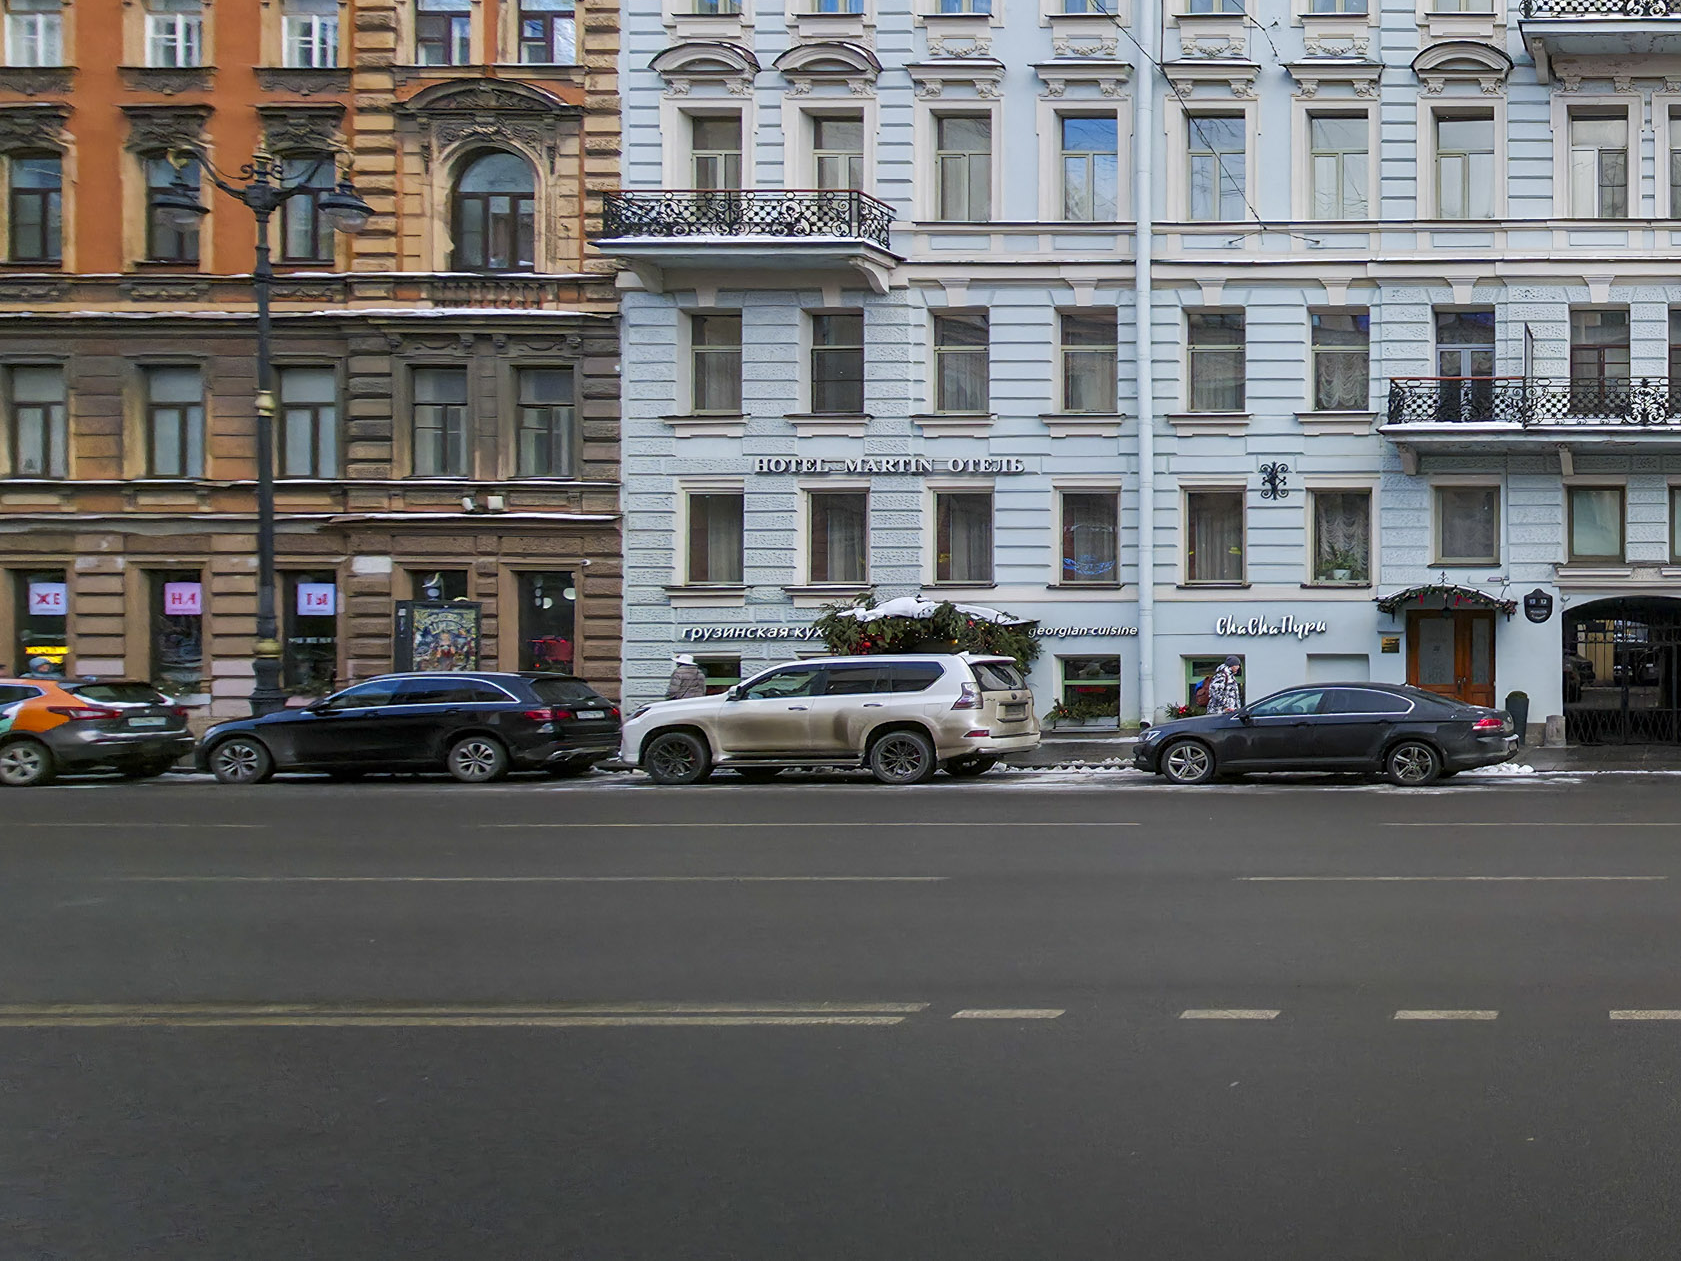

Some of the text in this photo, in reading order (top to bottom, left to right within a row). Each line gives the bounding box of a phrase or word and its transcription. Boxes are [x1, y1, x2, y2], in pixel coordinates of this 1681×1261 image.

[755, 457, 1025, 473] HOTEL MARTIN ОТЕЛЬ
[681, 626, 828, 641] грузинская кух
[1028, 625, 1138, 638] georgian cuisine
